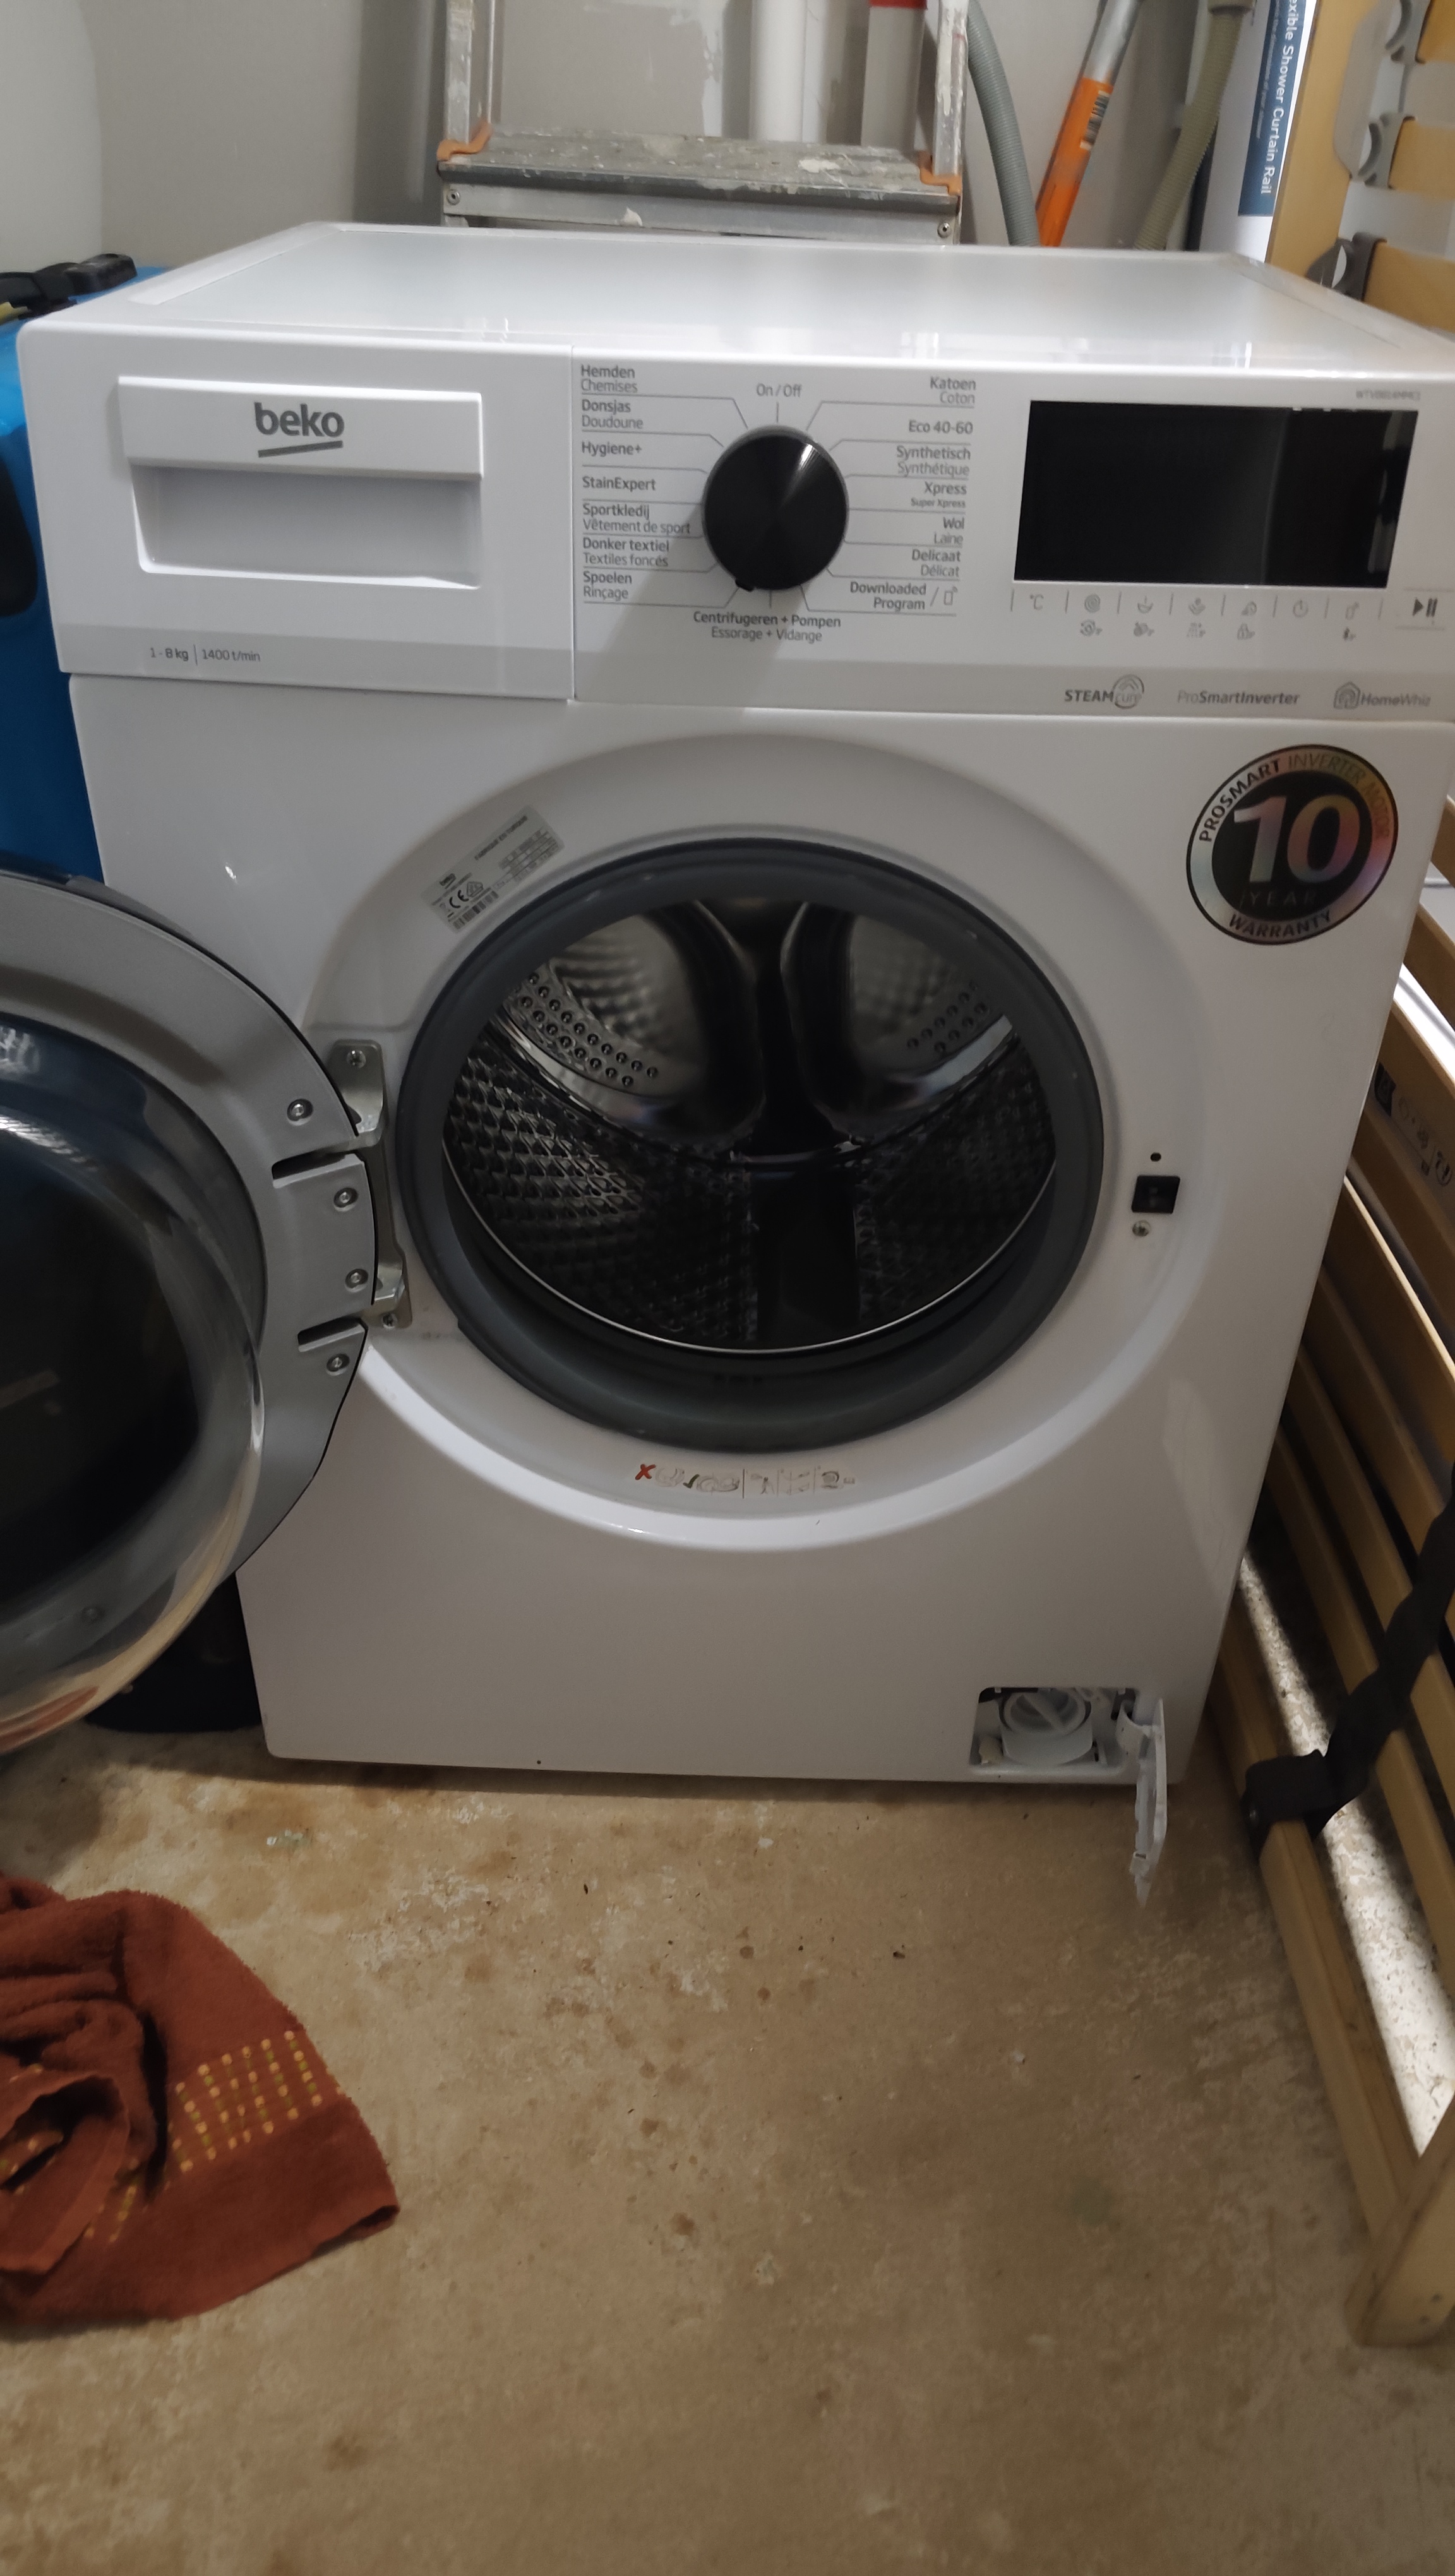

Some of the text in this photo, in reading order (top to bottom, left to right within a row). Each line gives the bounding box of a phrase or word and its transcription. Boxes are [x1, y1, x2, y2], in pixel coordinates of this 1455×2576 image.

[1276, 45, 1294, 104] Shower
[1266, 107, 1284, 162] Curtain
[1260, 165, 1275, 194] Rail
[582, 364, 635, 378] Hemden
[581, 379, 638, 393] Chemises
[757, 383, 773, 397] On
[783, 383, 802, 397] Off
[930, 376, 976, 390] Katoen
[939, 391, 975, 405] Coton
[582, 399, 631, 415] Donsjas
[254, 402, 345, 438] beko
[582, 415, 643, 429] Doudoune
[908, 419, 973, 434] Eco 40-60
[582, 441, 642, 457] Hygiene+
[896, 445, 971, 460] Synthetisch
[897, 461, 970, 479] Synthétique
[582, 476, 656, 492] StainExpert
[924, 481, 967, 496] Xpress
[911, 497, 966, 508] Super Xpress
[583, 503, 649, 520] Sportkledij
[583, 518, 690, 535] Vêtement de sport
[943, 516, 965, 529] Wol
[583, 537, 669, 552] Donker textiel
[933, 532, 964, 545] Laine
[583, 552, 668, 567] Textiles foncés
[912, 549, 961, 562] Delicaat
[583, 570, 632, 585] Spoelen
[921, 564, 960, 577] Délicat
[584, 585, 629, 601] Rinçage
[850, 581, 926, 595] Downloaded
[873, 596, 925, 612] Program
[693, 611, 778, 627] Centrifugeren
[791, 614, 841, 629] Pompen
[712, 625, 763, 641] Essorage
[776, 628, 822, 644] Vidange
[202, 648, 230, 660] 1400
[232, 649, 260, 662] t/min
[1064, 689, 1114, 703] STEAM
[1178, 689, 1300, 705] ProSmartInverter
[1199, 758, 1281, 842] PROSMART
[1288, 753, 1367, 784] INVERTER
[1234, 794, 1360, 883] 10
[1229, 910, 1332, 938] WARRANTY
